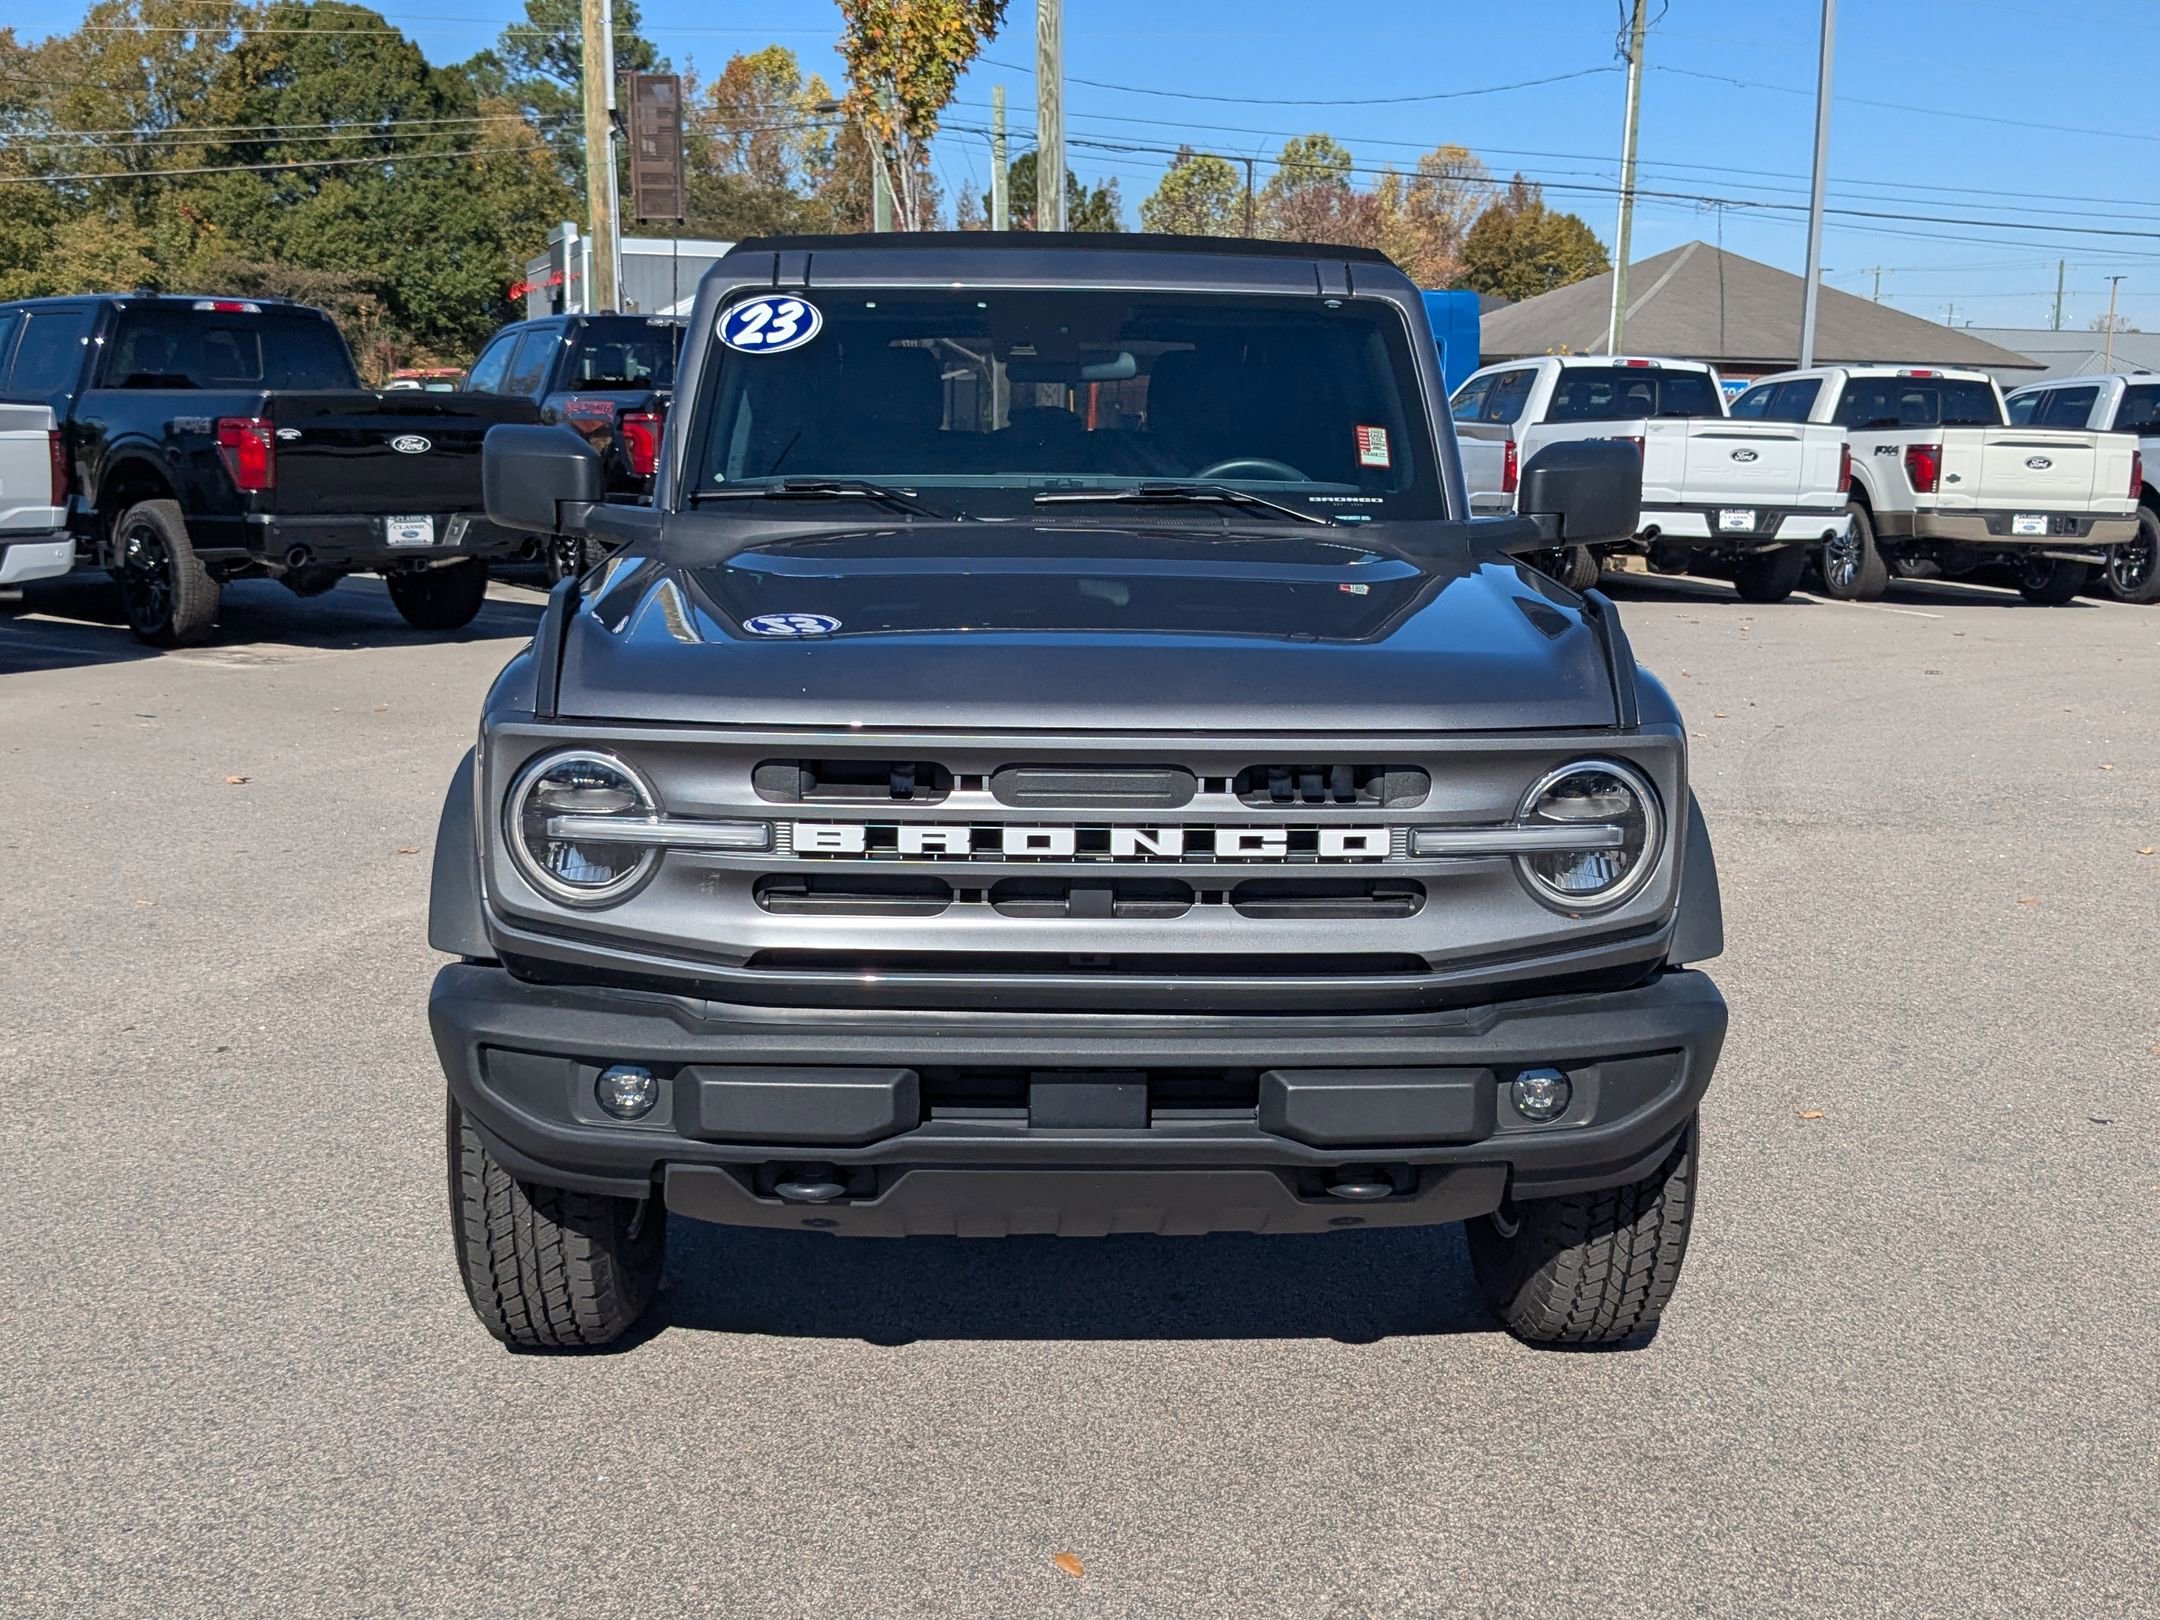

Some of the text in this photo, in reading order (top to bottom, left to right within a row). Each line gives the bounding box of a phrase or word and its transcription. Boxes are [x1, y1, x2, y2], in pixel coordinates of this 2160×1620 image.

[732, 301, 805, 345] 23
[397, 437, 427, 451] Ford
[1874, 445, 1900, 456] FX4
[793, 822, 1391, 857] BRONCO
